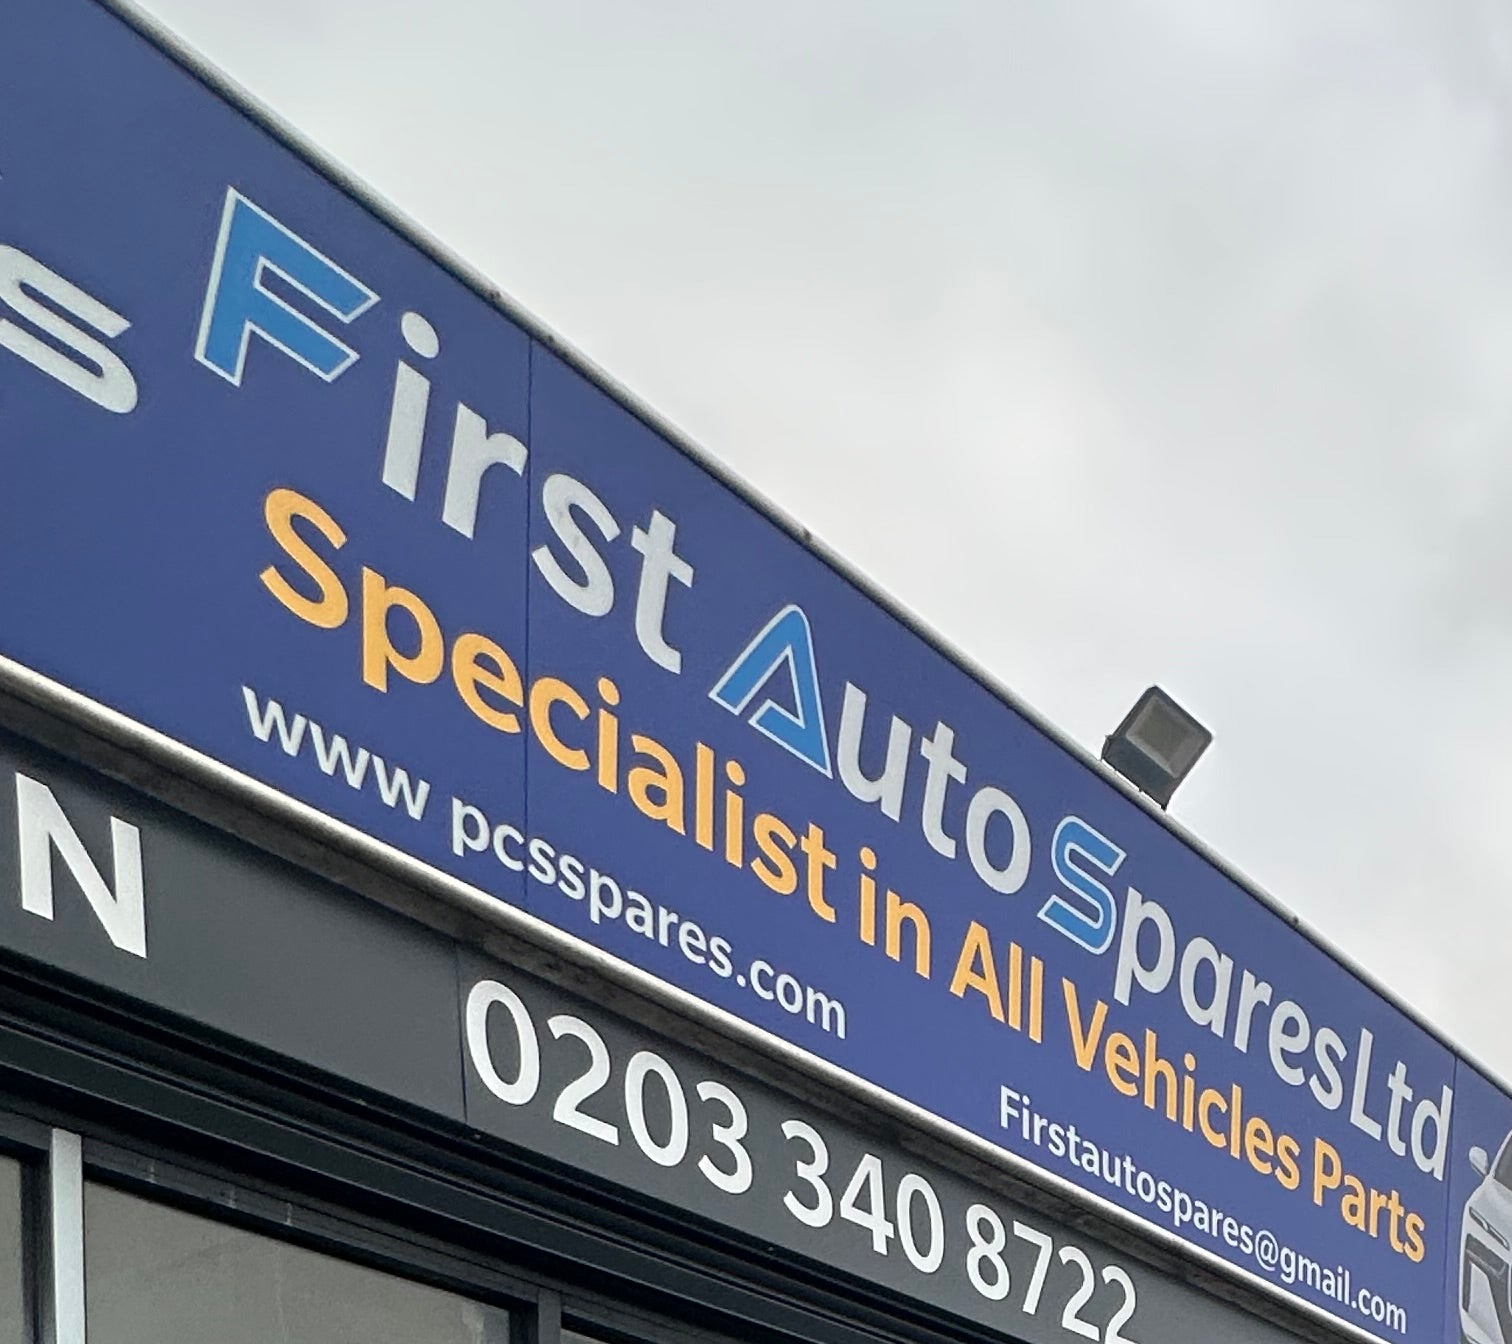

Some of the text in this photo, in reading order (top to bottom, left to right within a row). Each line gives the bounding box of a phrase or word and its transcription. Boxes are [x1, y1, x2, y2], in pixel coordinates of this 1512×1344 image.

[193, 185, 694, 675] First
[708, 603, 1032, 895] Auto
[14, 772, 148, 959] N
[242, 684, 847, 1040] www pcsspares.com
[262, 488, 1425, 1264] Specialist in All Vehicles Parts
[465, 979, 754, 1194] 0203
[780, 1118, 945, 1275] 340
[1000, 1084, 1407, 1335] Firstautospares@gmail.com
